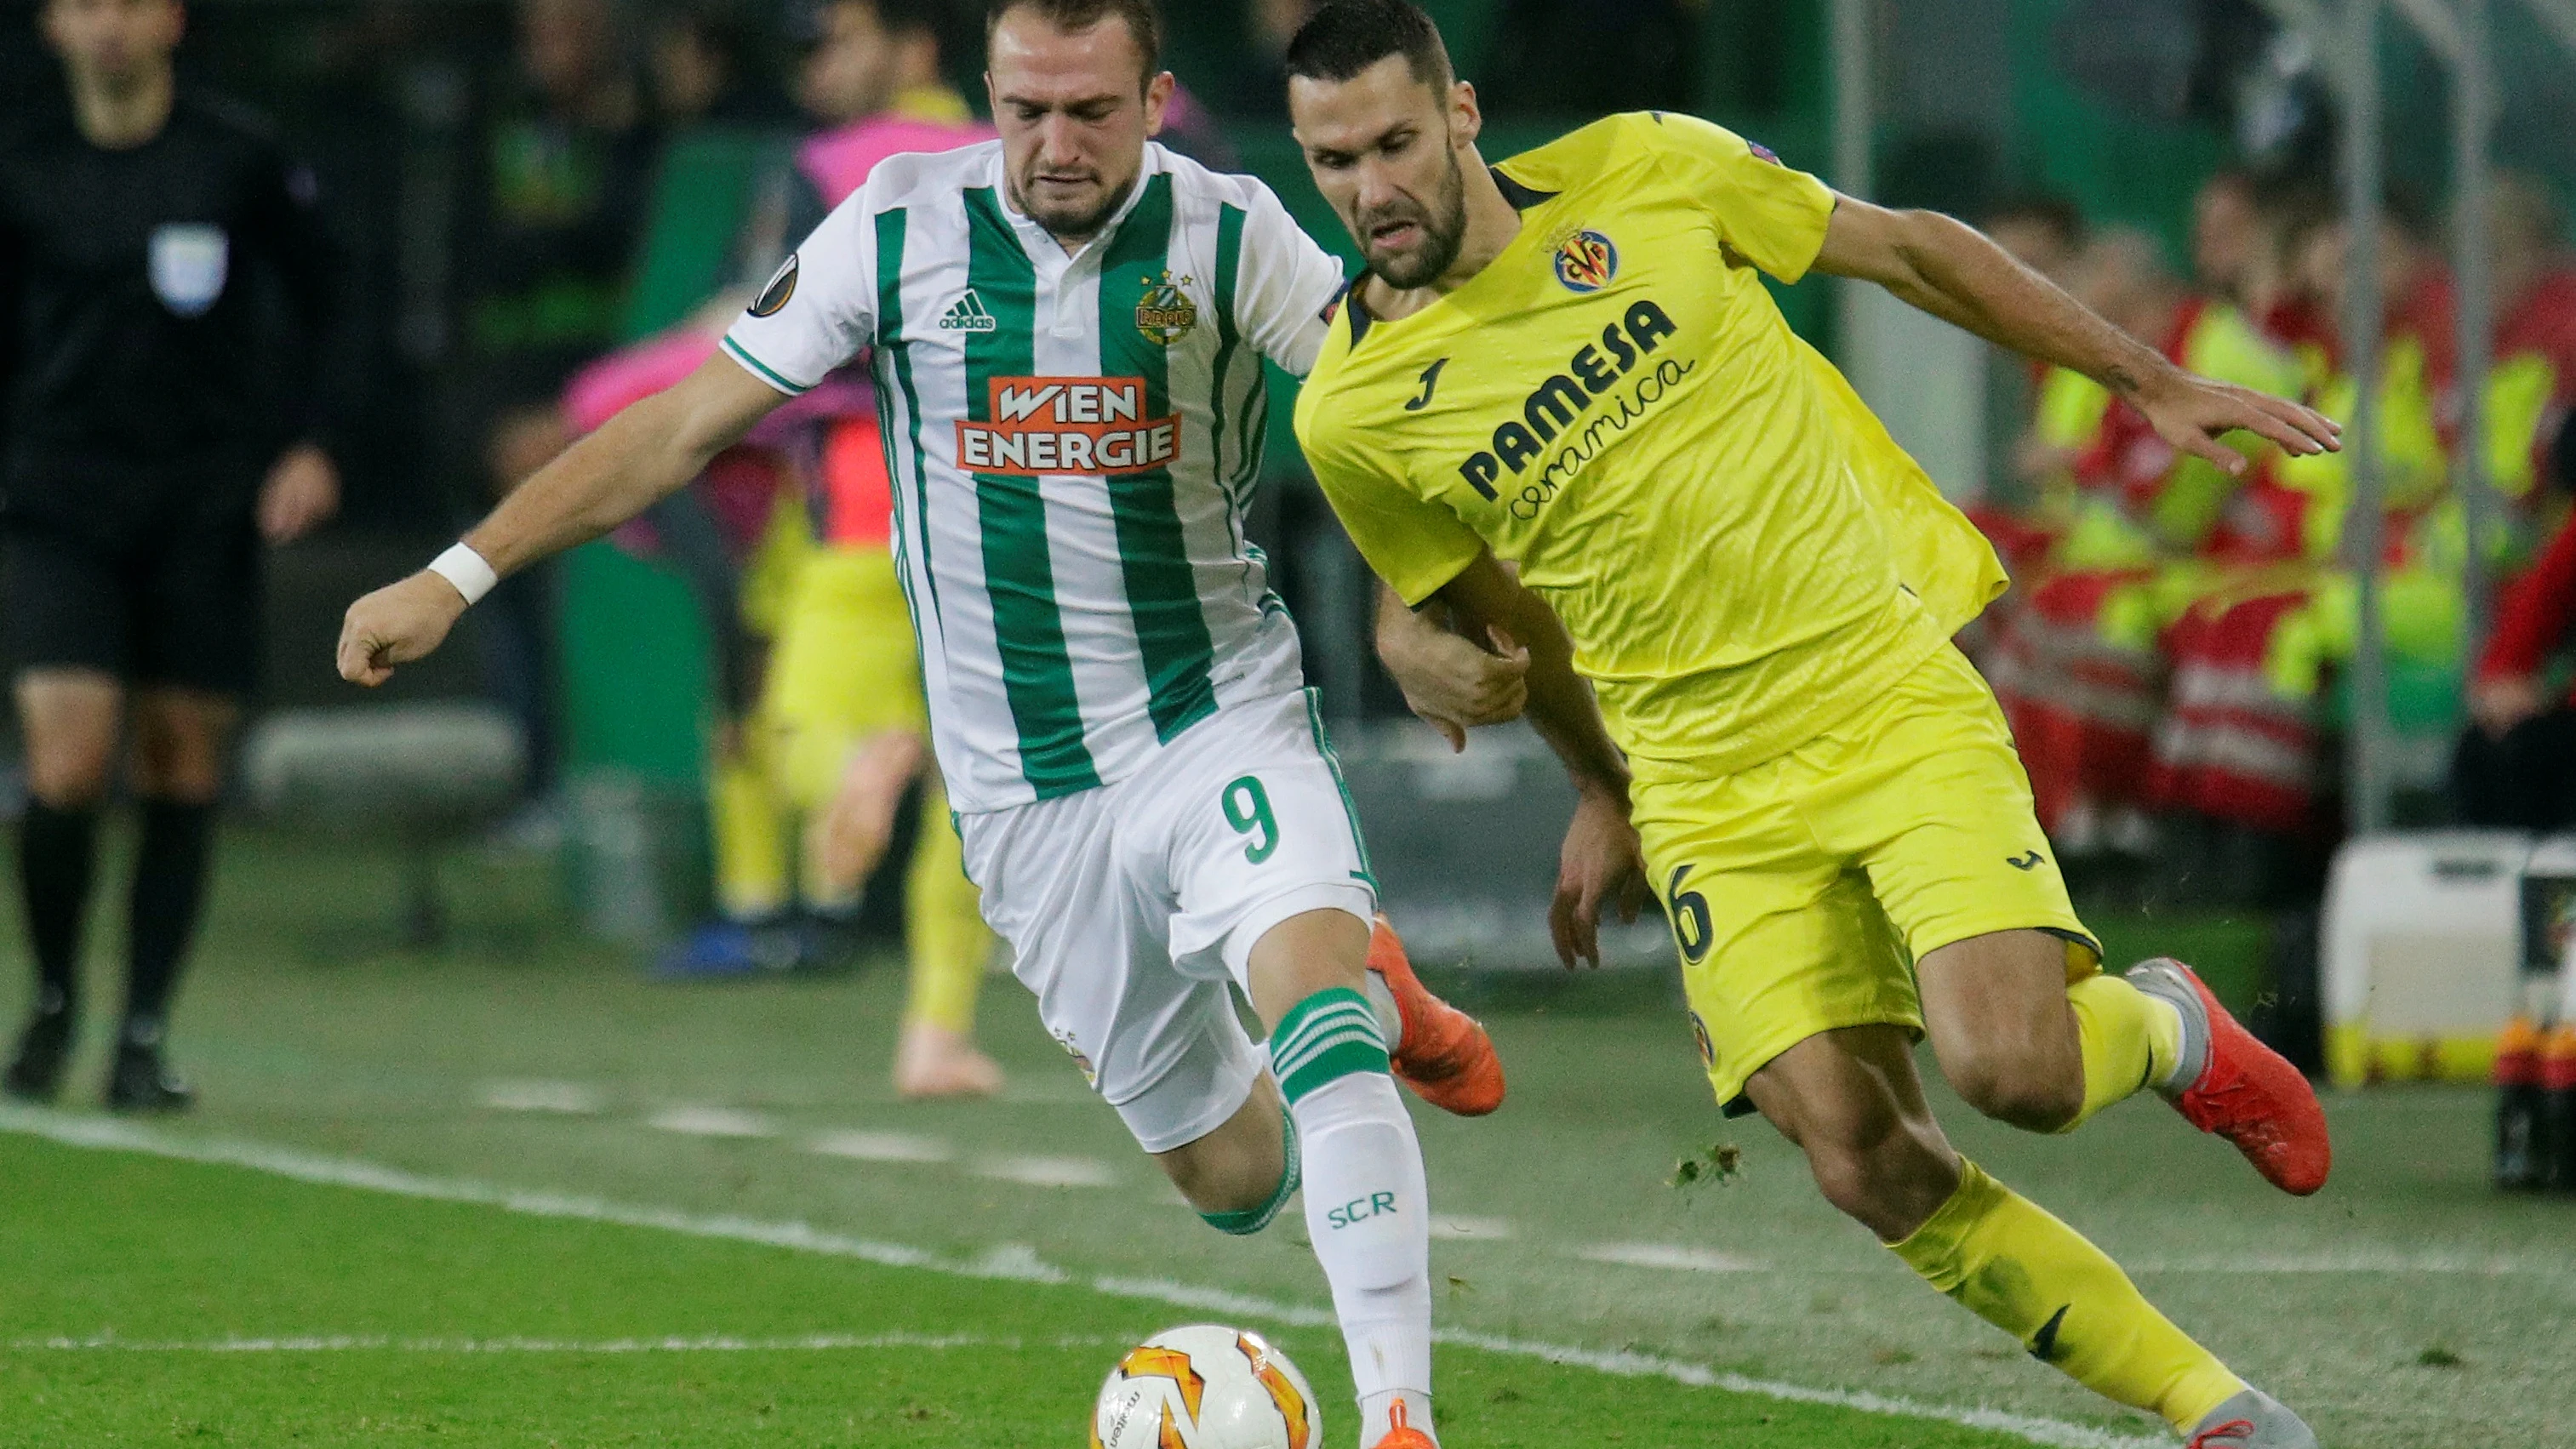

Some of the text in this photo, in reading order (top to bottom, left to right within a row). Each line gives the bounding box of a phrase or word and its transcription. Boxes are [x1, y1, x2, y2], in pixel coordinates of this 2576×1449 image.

[940, 315, 994, 329] adidas
[1139, 309, 1194, 326] RAPID
[1458, 299, 1678, 504] PAMESA
[962, 424, 1175, 470] ENERGIE
[1510, 358, 1696, 521] ceramica
[1220, 774, 1280, 866] 9
[1668, 864, 1714, 966] 6
[1328, 1191, 1397, 1230] SCR
